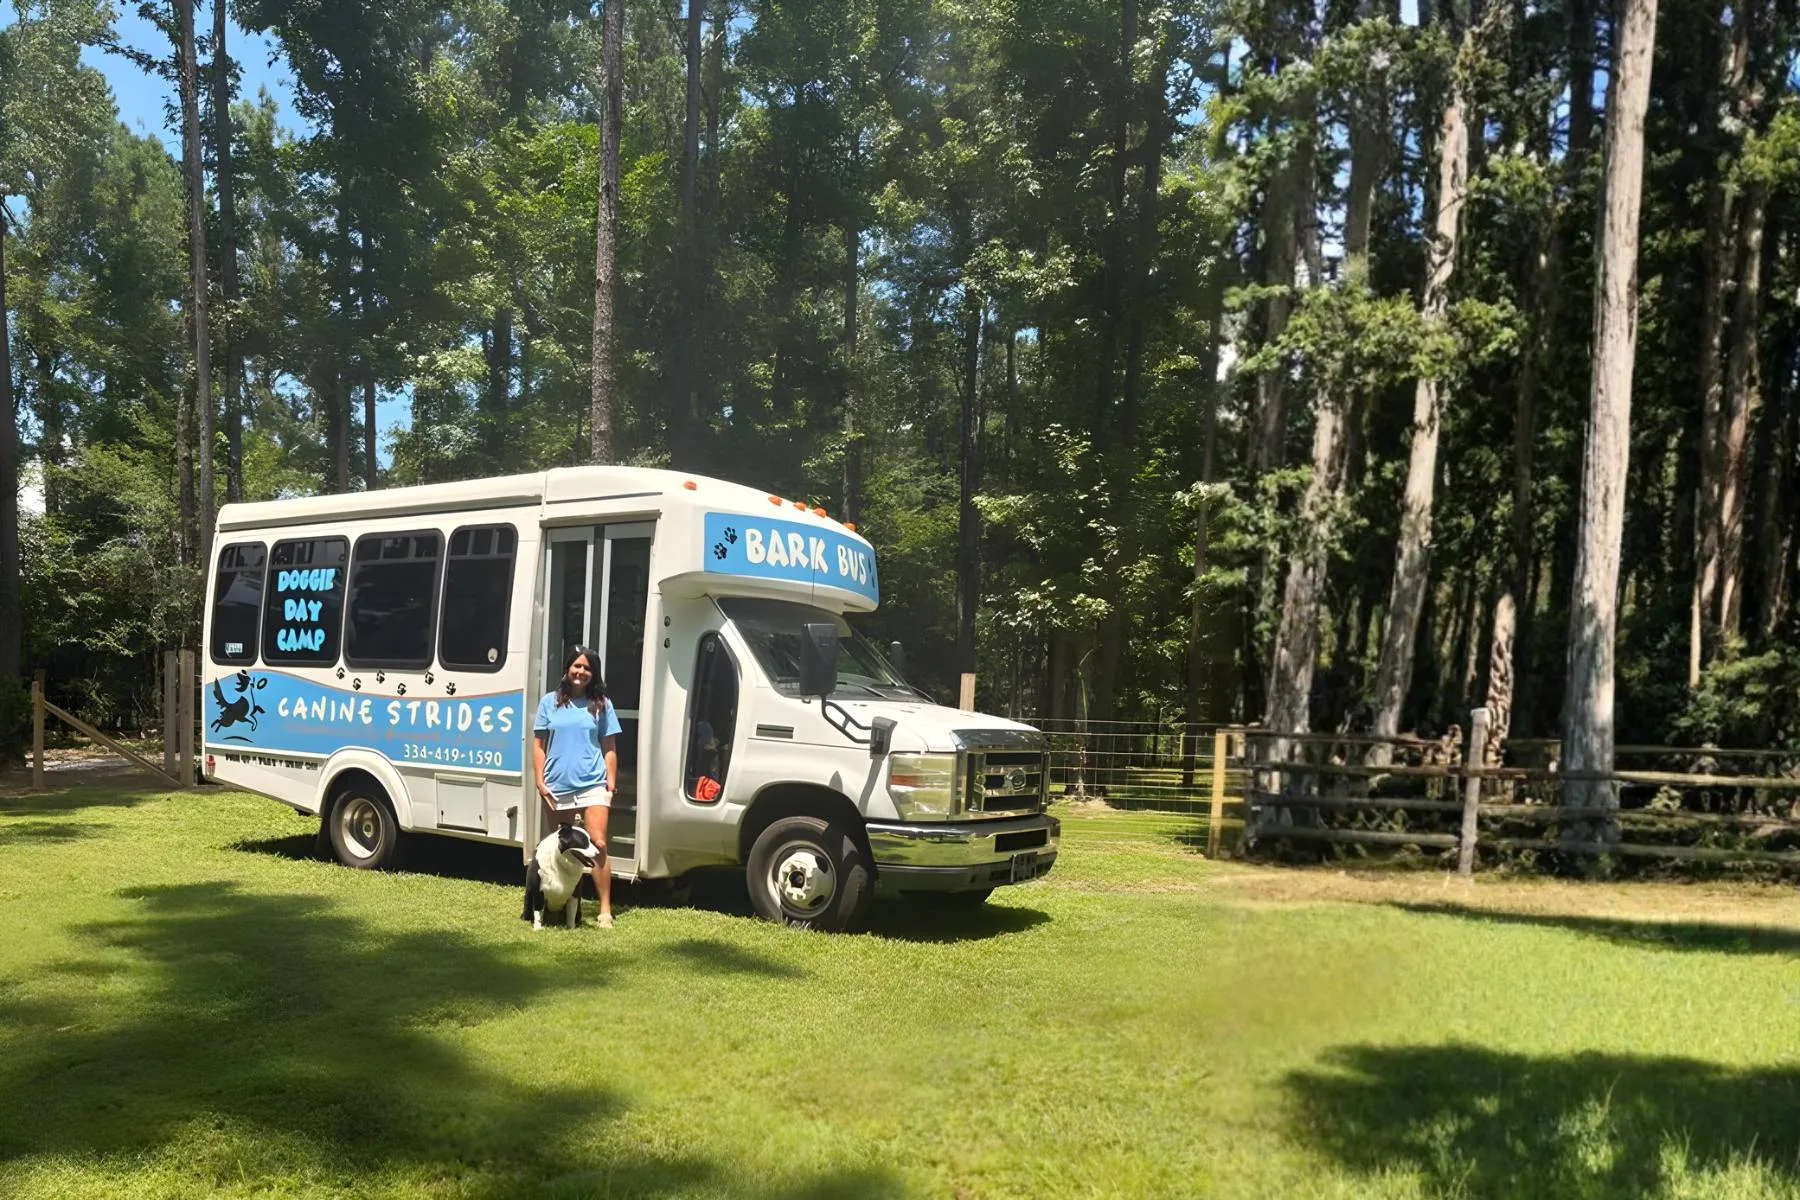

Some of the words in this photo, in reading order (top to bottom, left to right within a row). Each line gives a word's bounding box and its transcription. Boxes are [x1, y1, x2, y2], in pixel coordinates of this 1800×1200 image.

[745, 528, 828, 574] BARK
[837, 544, 867, 586] BUS
[277, 568, 336, 593] DOGGIE
[284, 598, 323, 622] DAY
[276, 628, 325, 652] CAMP
[278, 696, 373, 725] CANINE
[387, 700, 515, 733] STRIDES
[403, 744, 503, 767] 334-419-1590
